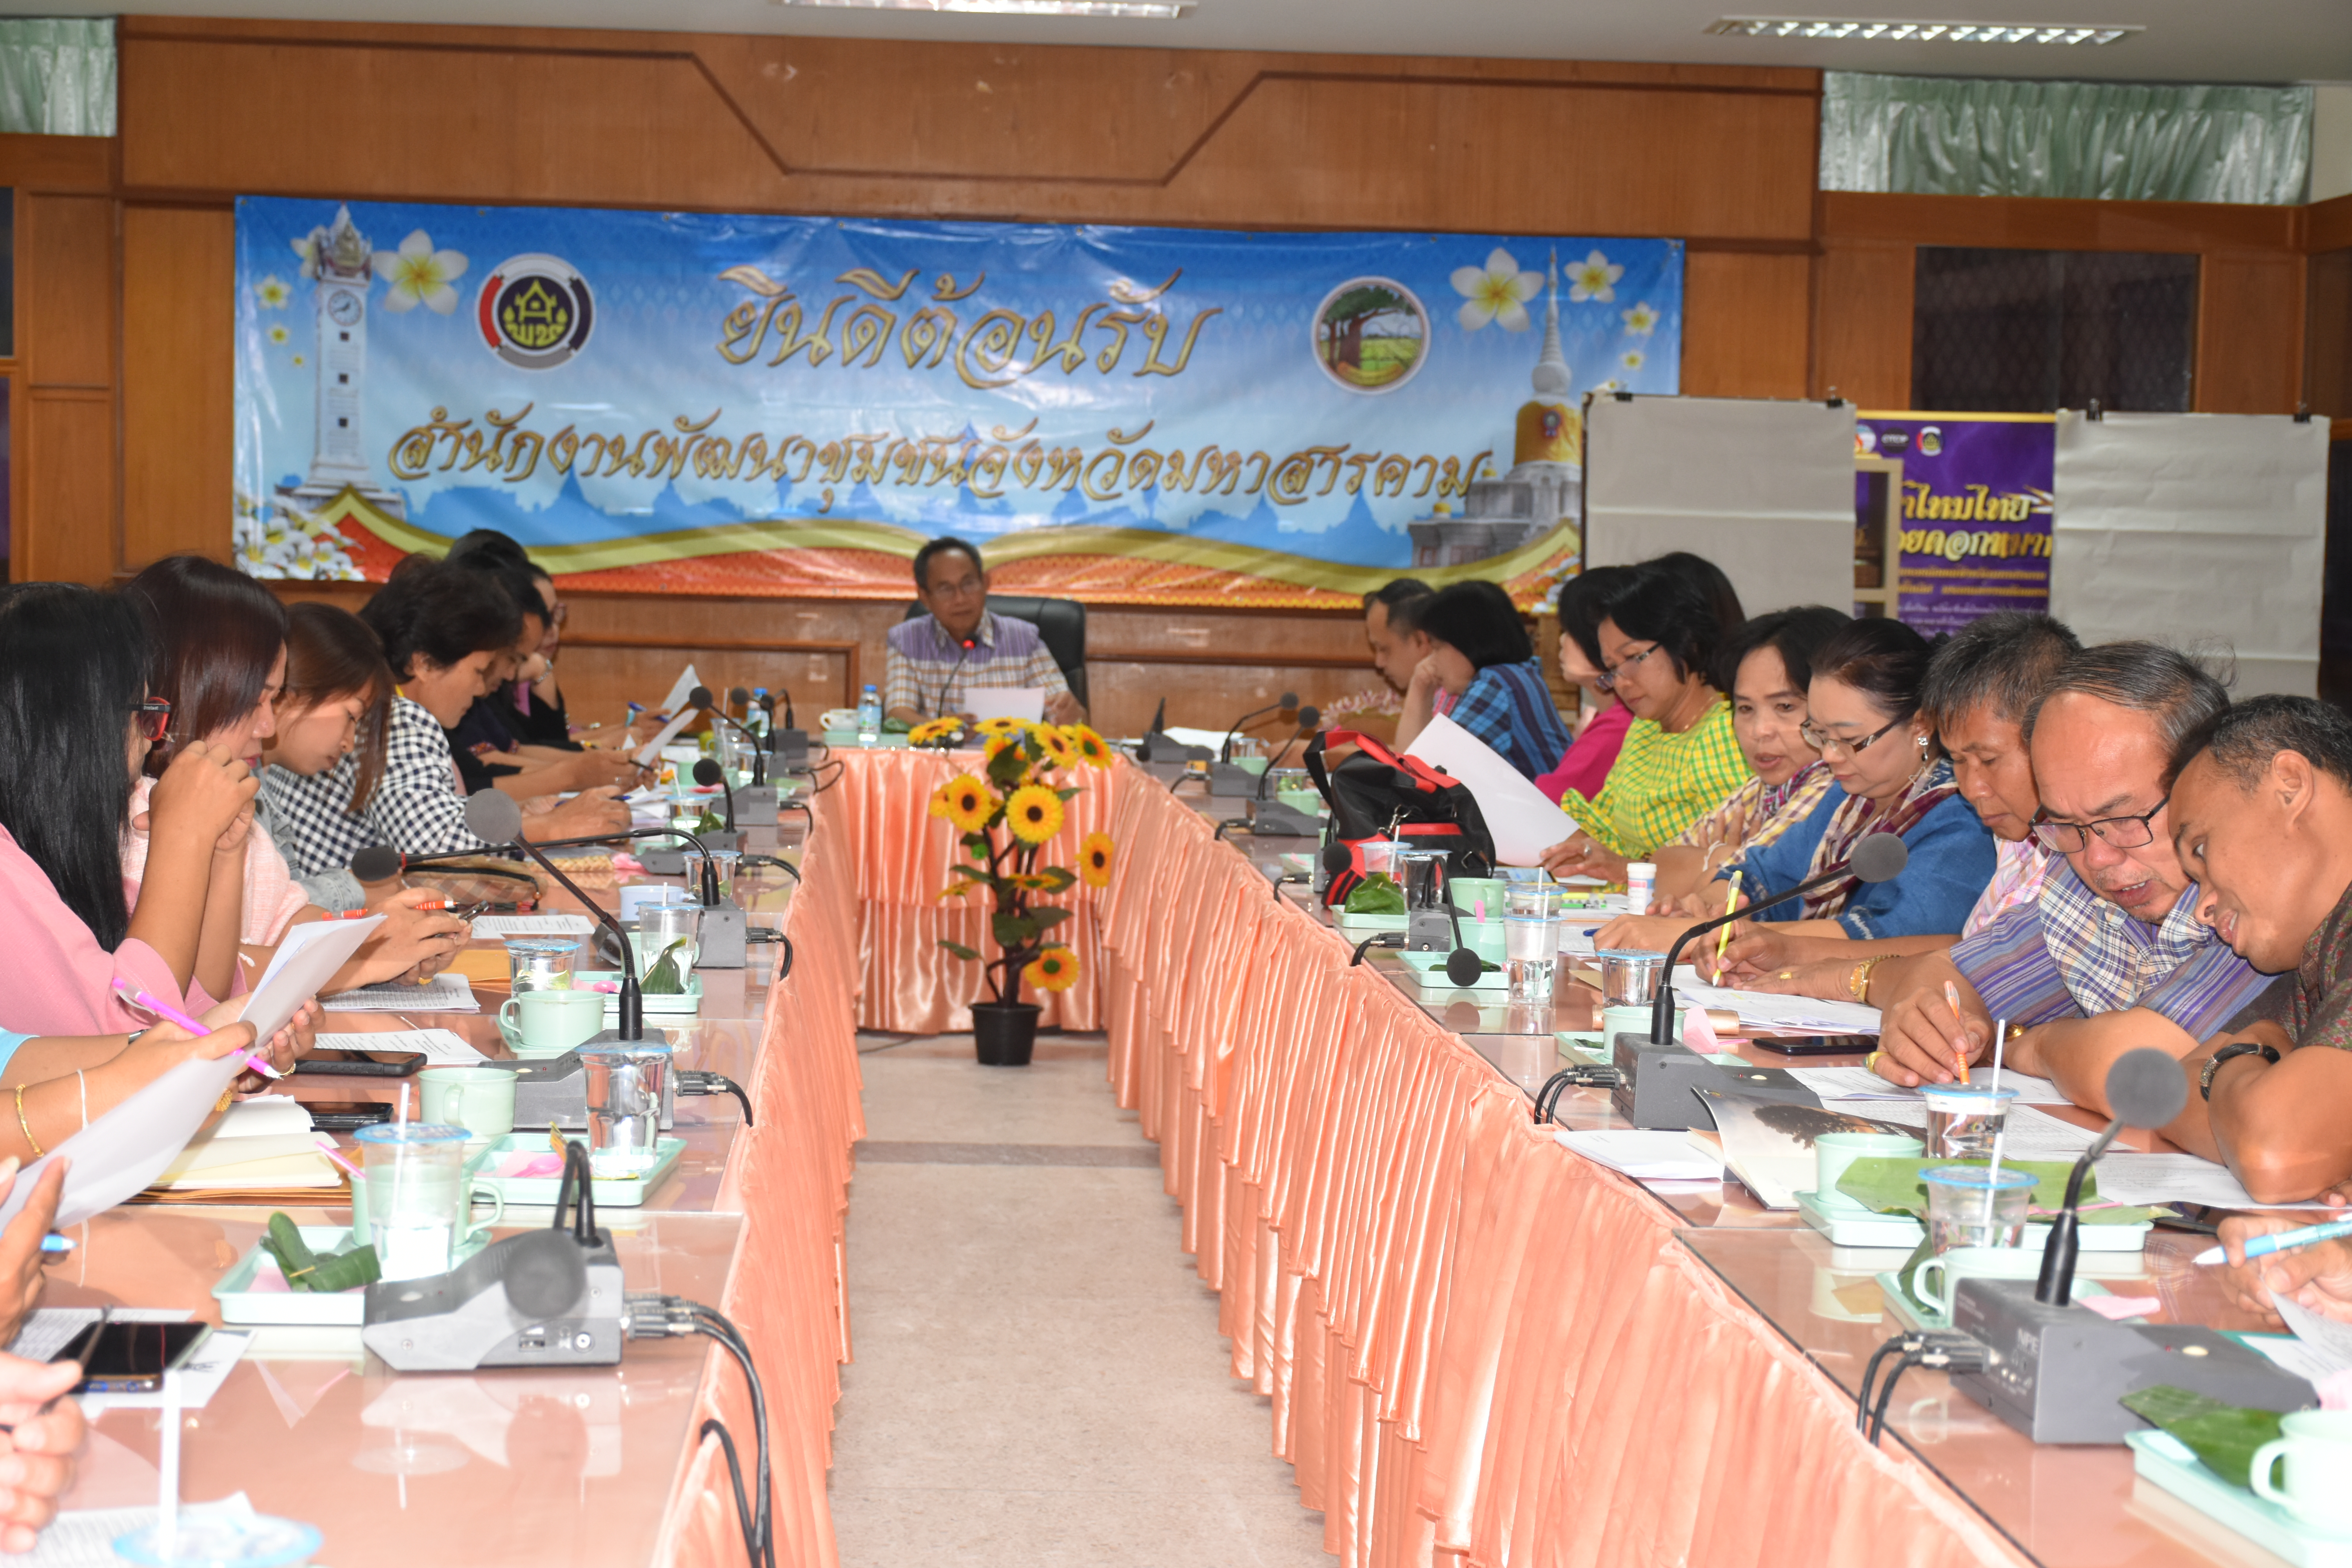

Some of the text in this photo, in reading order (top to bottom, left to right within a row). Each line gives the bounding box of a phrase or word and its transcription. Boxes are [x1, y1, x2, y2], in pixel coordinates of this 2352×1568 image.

[716, 268, 1223, 388] ยินดีต้อนรับ
[388, 402, 1494, 514] สำนักงานพัฒนาชุมชนจังหวัดมหาสารคาม
[1902, 480, 2031, 521] าไหมไทย
